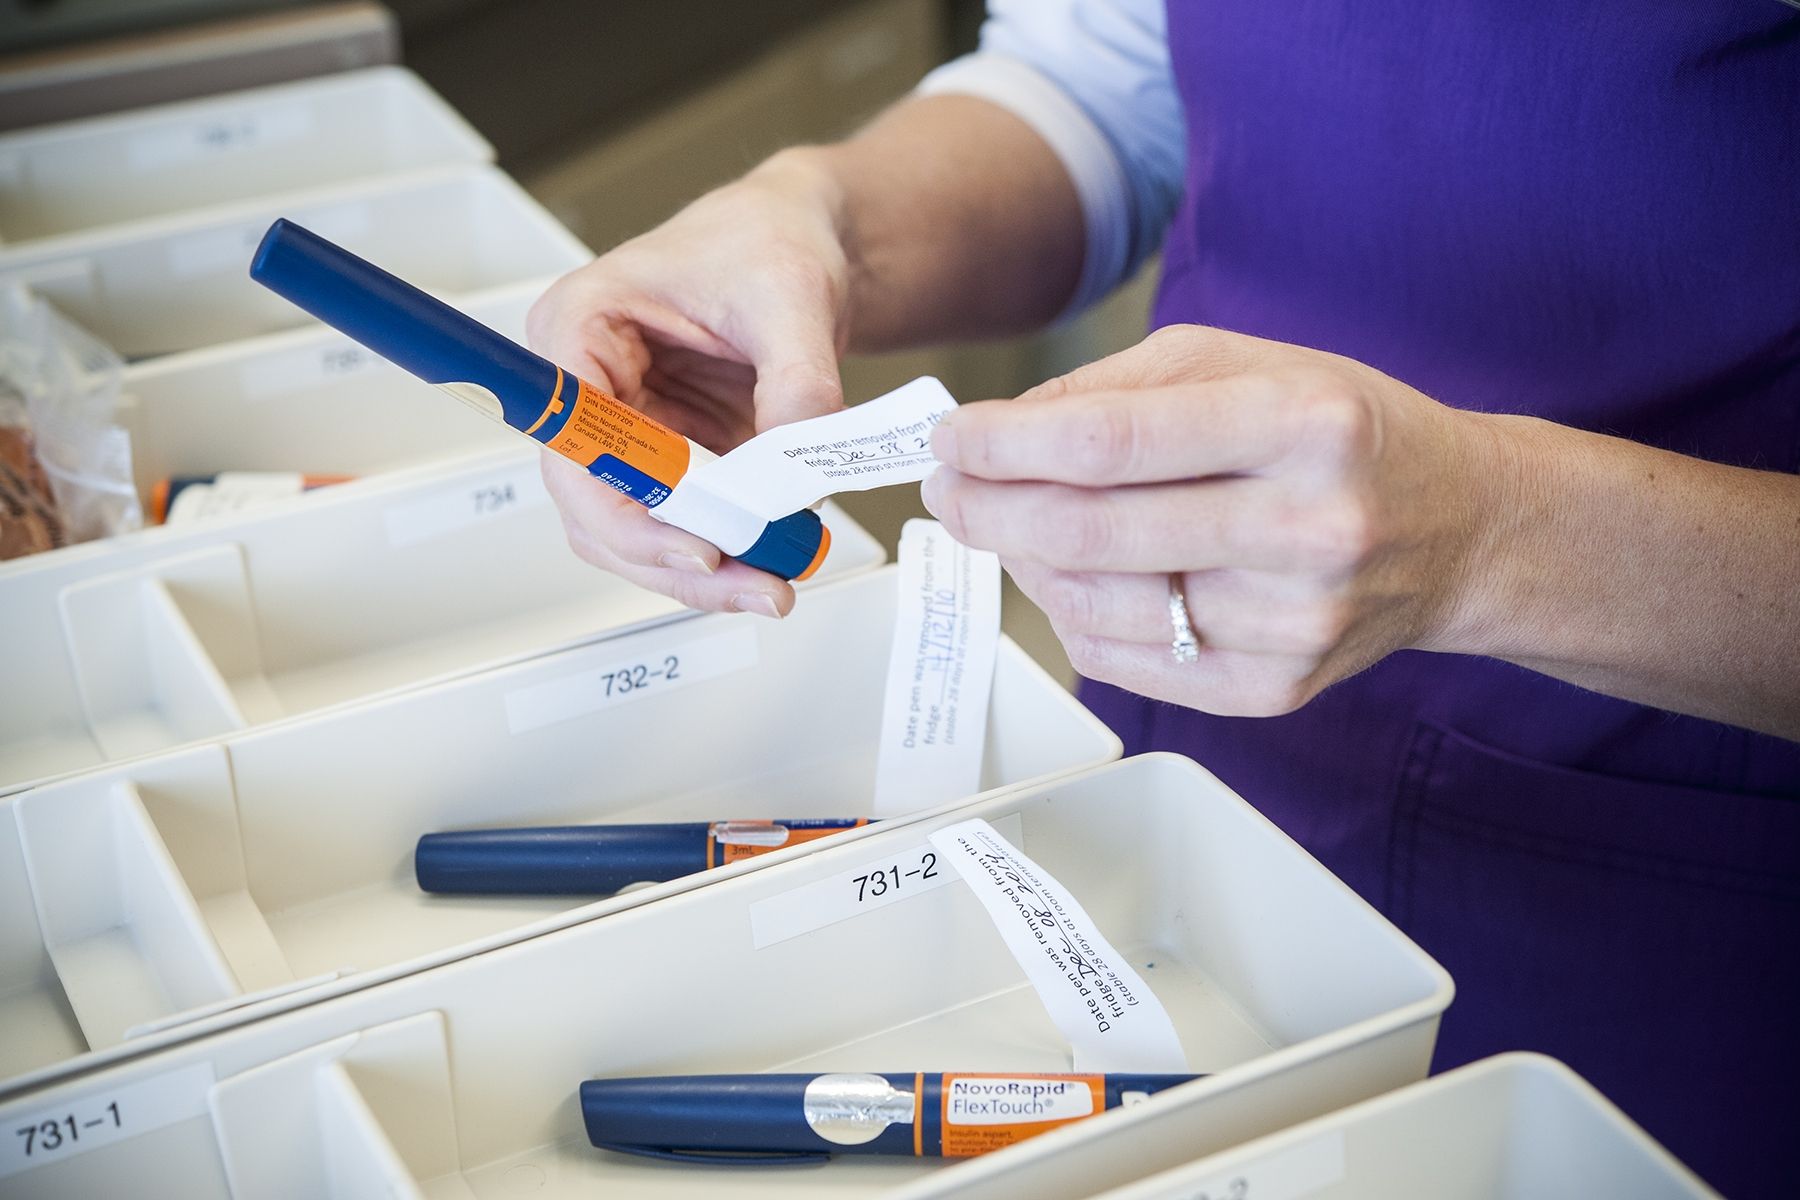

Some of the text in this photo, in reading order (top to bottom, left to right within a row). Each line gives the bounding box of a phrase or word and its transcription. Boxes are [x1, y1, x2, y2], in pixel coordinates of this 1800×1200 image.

[581, 407, 660, 455] Novo Nordisk Canada Inc.
[584, 396, 634, 427] DIN 02377209
[573, 423, 598, 441] Canada
[598, 438, 614, 451] L4W
[578, 416, 630, 450] Mississauga, ON,
[783, 446, 810, 459] Date
[810, 443, 831, 457] pen
[830, 439, 852, 451] was
[851, 429, 898, 448] removed
[895, 420, 928, 442] from
[830, 450, 876, 463] Dec
[880, 441, 904, 455] 08
[804, 455, 837, 469] fridge
[851, 466, 864, 475] 28
[863, 463, 885, 474] days
[883, 461, 896, 470] at
[903, 536, 935, 748] Date pen was removed from the
[601, 655, 680, 697] 732-2
[923, 704, 941, 745] fridge
[852, 852, 939, 902] 731-2
[957, 838, 1111, 1033] Date pen was removed from the
[976, 831, 1139, 1006] (stable 28 days at room temperature)
[984, 853, 1097, 980] Dec 08 2014
[1094, 979, 1125, 1018] fridge
[16, 1101, 121, 1156] 731-1
